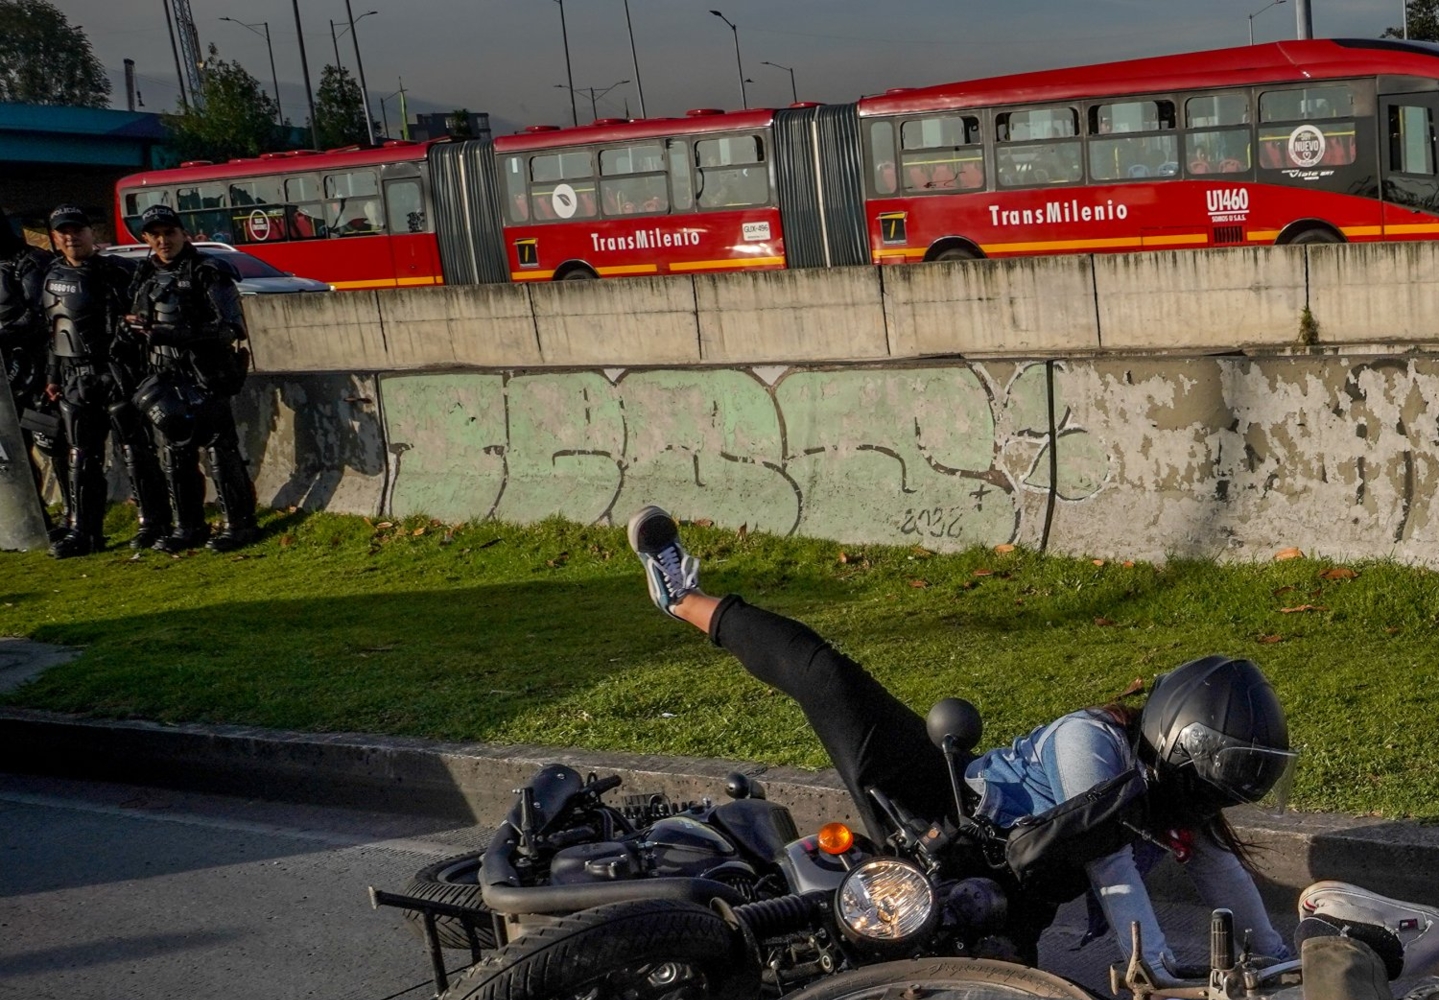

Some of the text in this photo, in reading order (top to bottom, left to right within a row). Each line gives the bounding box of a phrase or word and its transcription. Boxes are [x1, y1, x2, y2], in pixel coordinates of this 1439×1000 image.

[1294, 140, 1319, 152] NUEVO
[1206, 188, 1249, 211] U1460
[988, 199, 1128, 226] TransMilenio
[591, 227, 700, 252] TransMilenio
